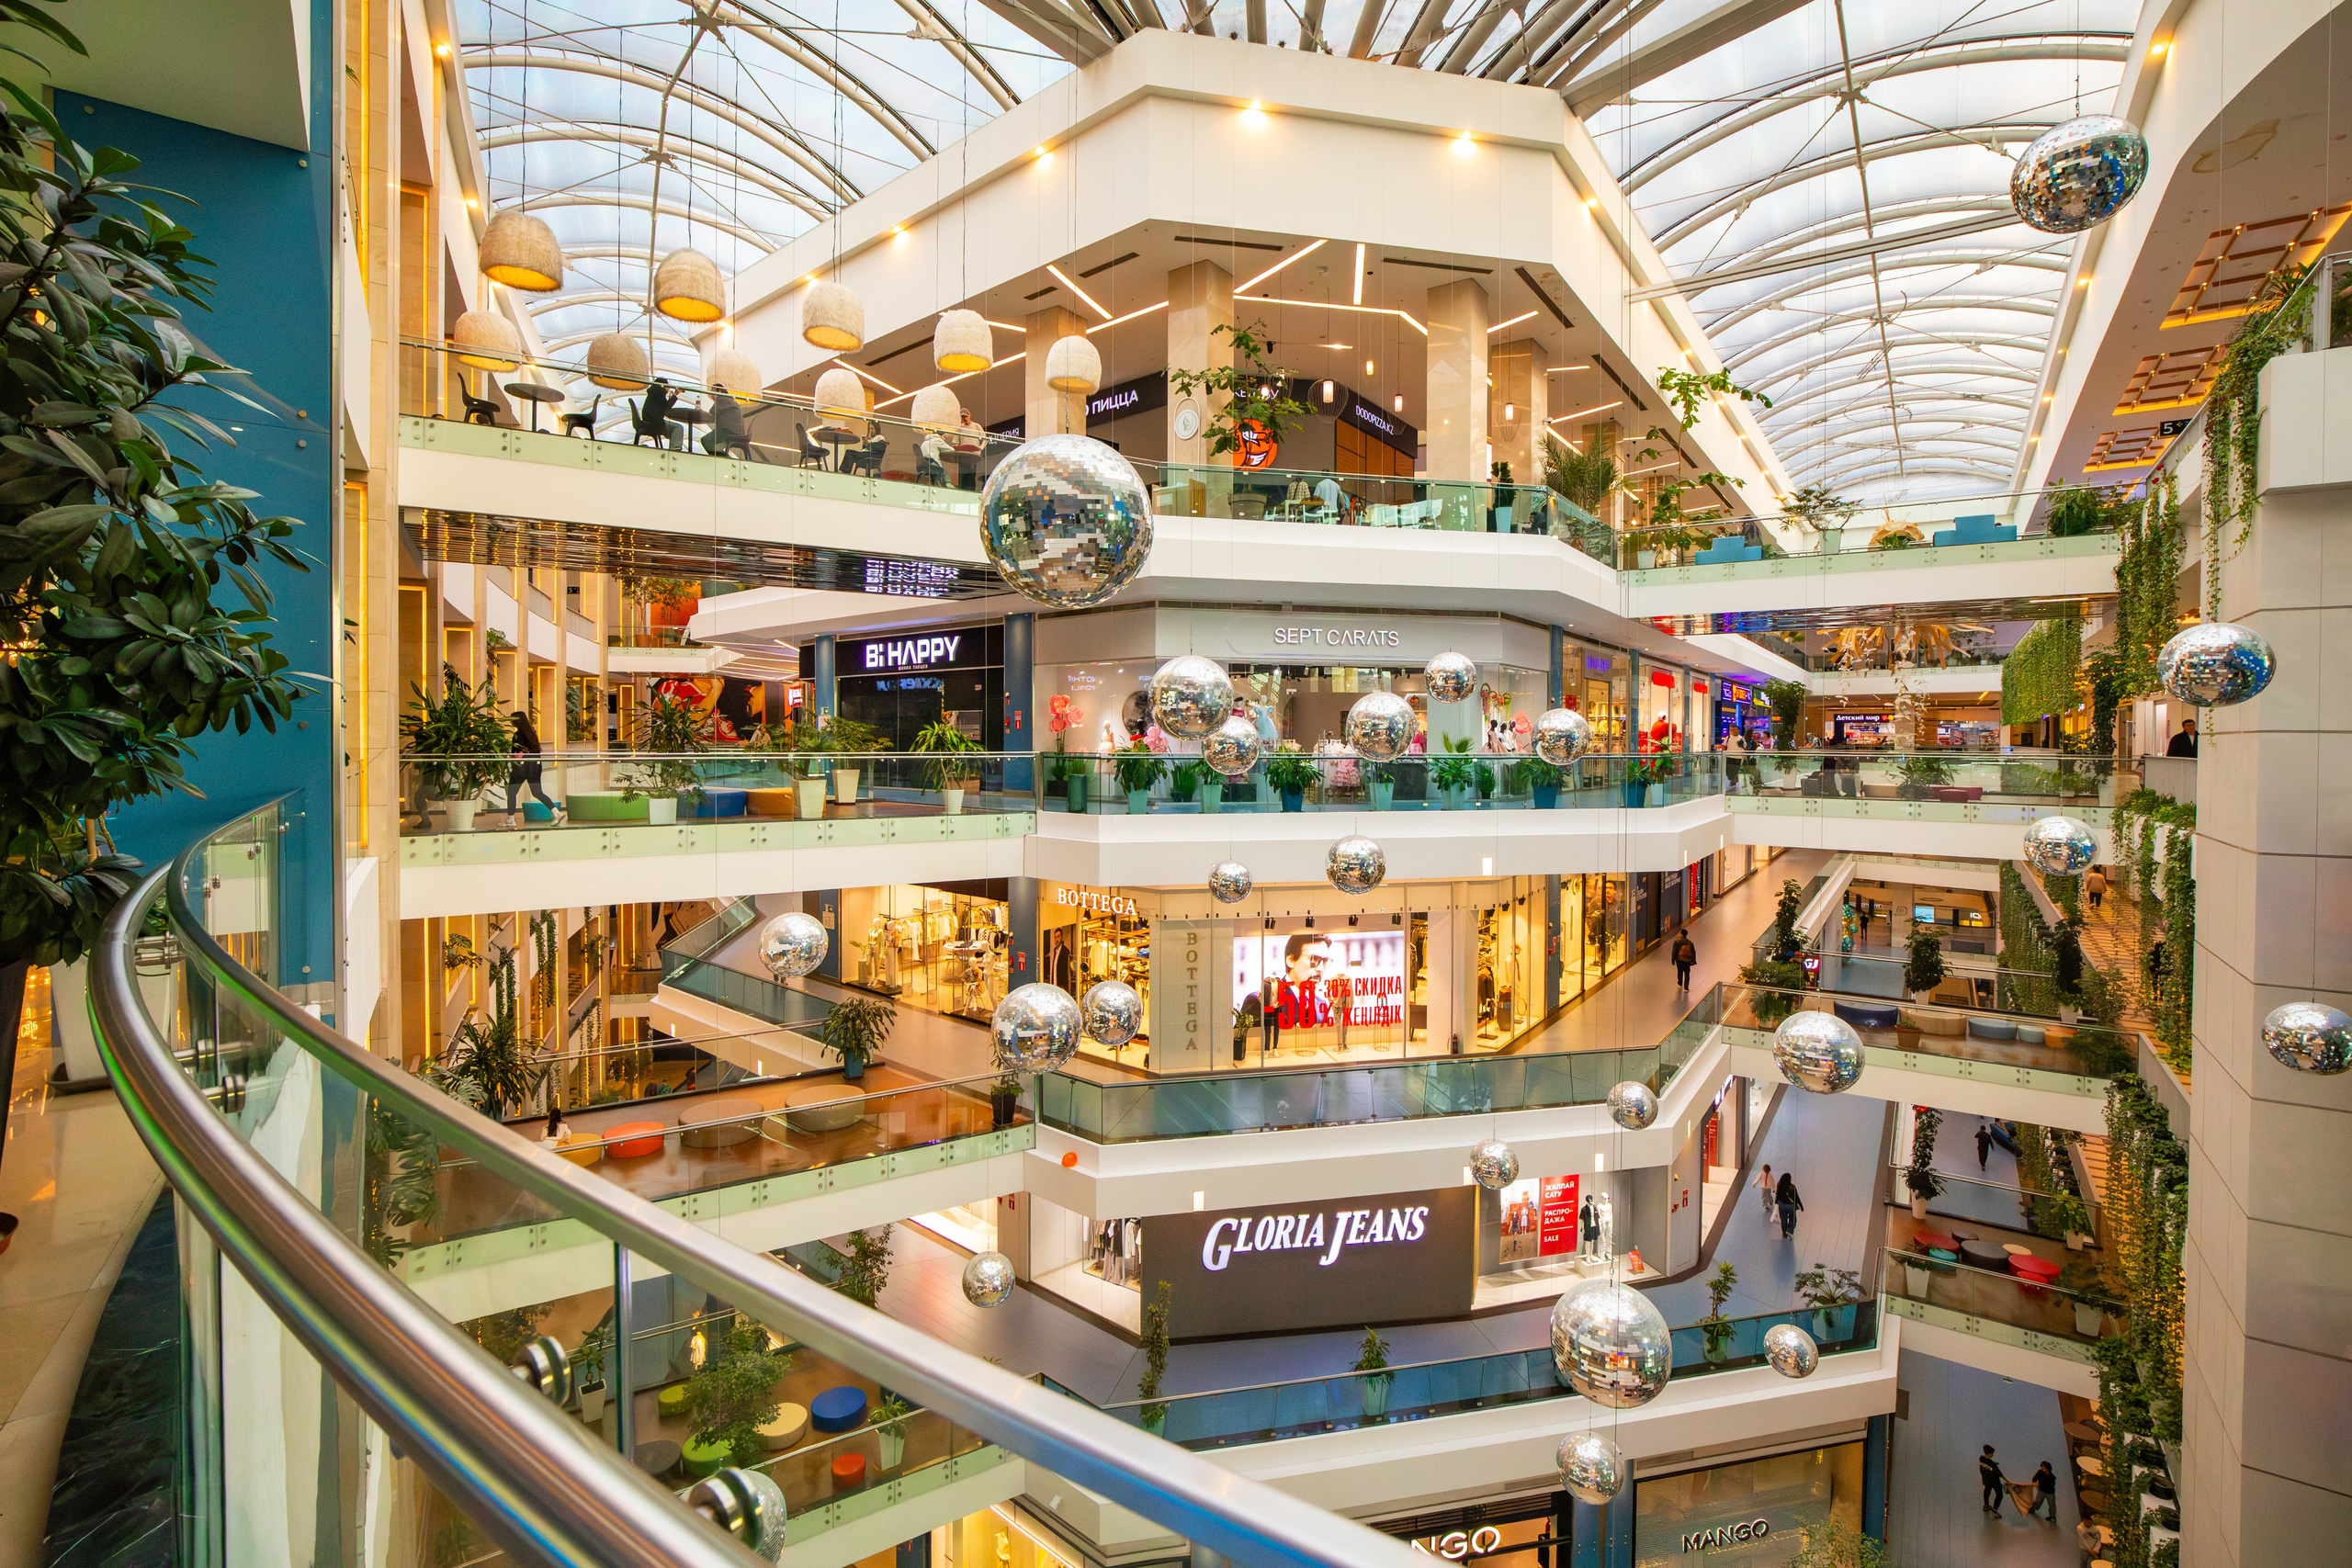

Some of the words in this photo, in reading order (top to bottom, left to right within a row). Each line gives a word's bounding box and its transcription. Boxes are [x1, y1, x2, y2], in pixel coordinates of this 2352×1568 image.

[1091, 389, 1138, 415] ПИЦЦА
[2163, 423, 2174, 434] 5
[1274, 627, 1323, 644] SEPT
[1327, 629, 1399, 647] CARATS
[888, 636, 961, 666] HAPPY
[1057, 887, 1137, 916] BOTTEGA
[1185, 932, 1198, 1051] BOTTEGA
[1354, 976, 1402, 998] СКИДКА
[1544, 1181, 1575, 1191] ЖАППАЙ
[1544, 1190, 1563, 1199] САТУ
[1544, 1208, 1574, 1217] РАСПРО-
[1544, 1216, 1566, 1225] ДАЖА
[1202, 1217, 1325, 1272] GLORIA
[1318, 1205, 1430, 1267] JEANS
[1544, 1235, 1559, 1243] SALE
[1410, 1526, 1500, 1559] NGO
[1682, 1518, 1770, 1553] MANGO
